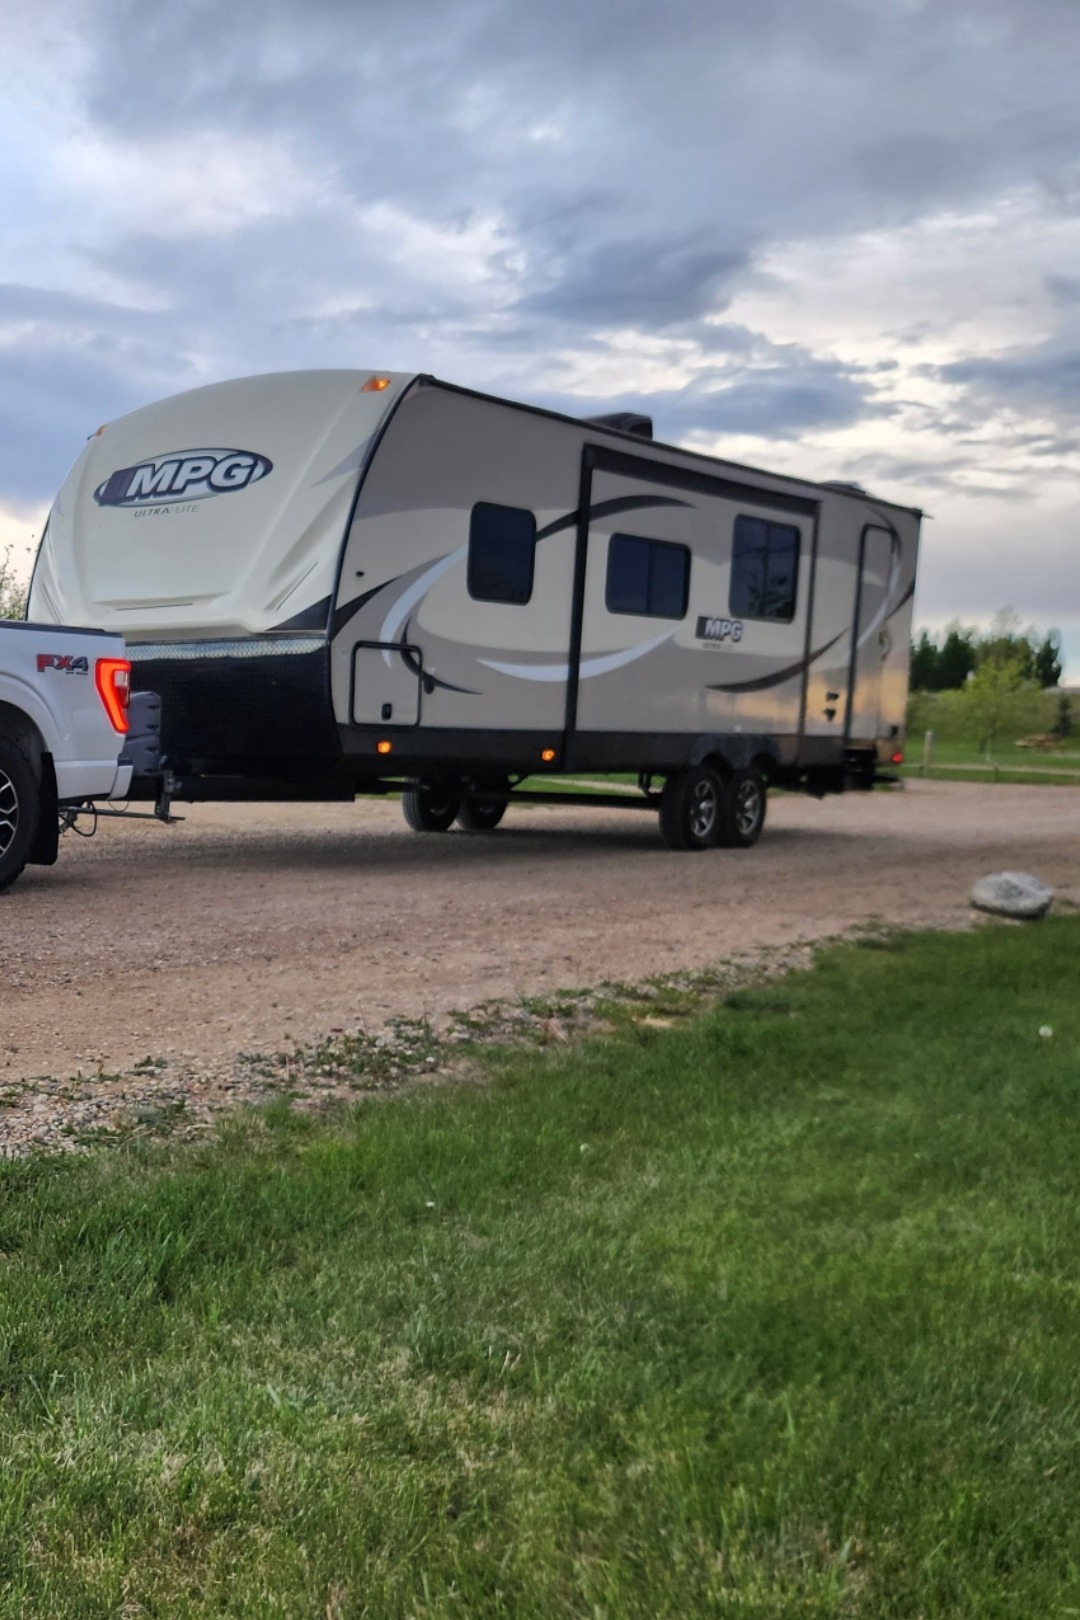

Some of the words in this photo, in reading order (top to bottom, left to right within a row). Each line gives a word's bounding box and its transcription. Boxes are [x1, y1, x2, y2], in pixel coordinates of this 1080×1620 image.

[125, 452, 256, 498] MPG
[134, 507, 170, 518] ULTRA
[703, 618, 743, 642] MPG
[36, 653, 88, 673] FX4
